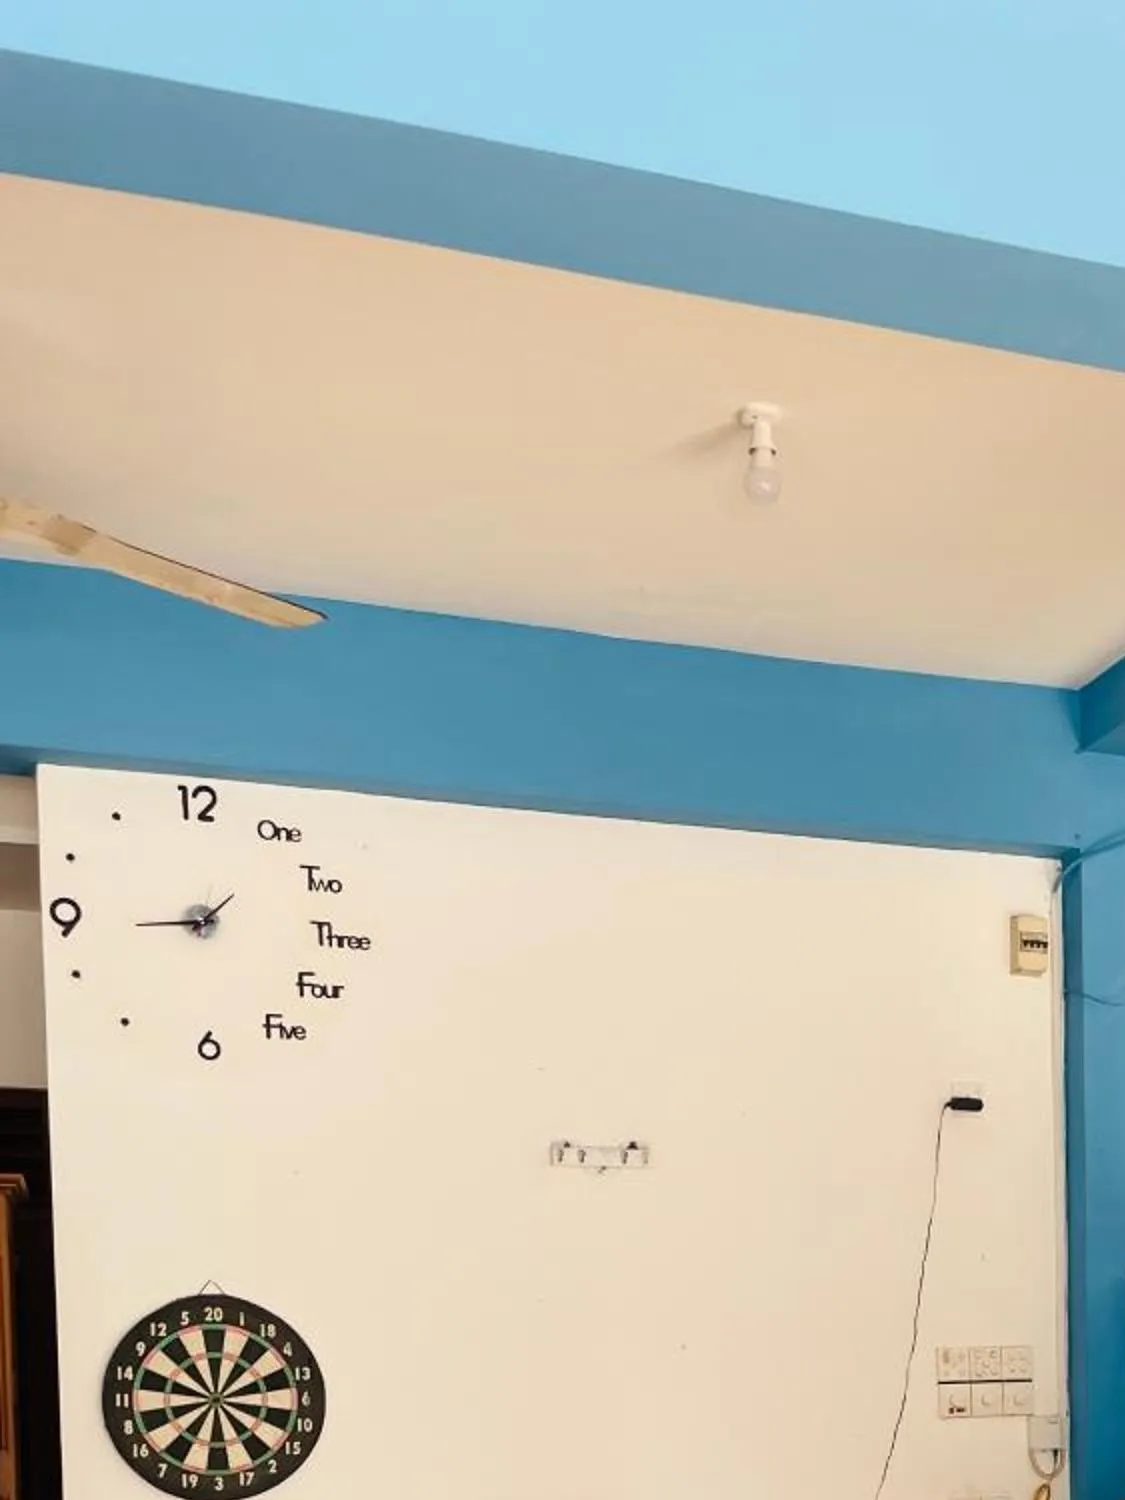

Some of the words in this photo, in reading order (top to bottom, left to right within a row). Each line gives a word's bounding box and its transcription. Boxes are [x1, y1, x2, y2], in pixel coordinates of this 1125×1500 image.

[177, 785, 218, 822] 12
[257, 819, 302, 843] One
[299, 864, 343, 893] Two
[50, 897, 82, 938] 9
[310, 920, 371, 951] Three
[296, 971, 345, 999] Four
[263, 1013, 307, 1041] Five
[197, 1030, 221, 1060] 6
[180, 1311, 190, 1325] 5
[204, 1307, 224, 1321] 20
[239, 1311, 246, 1326] 1
[150, 1323, 167, 1337] 12
[260, 1323, 276, 1338] 18
[136, 1341, 146, 1357] 9
[283, 1342, 293, 1357] 4
[116, 1366, 133, 1381] 14
[295, 1366, 311, 1381] 13
[115, 1393, 130, 1408] 11
[301, 1393, 311, 1406] 6
[123, 1419, 133, 1435] 8
[297, 1418, 314, 1432] 10
[132, 1443, 149, 1458] 16
[285, 1441, 302, 1455] 15
[156, 1463, 168, 1478] 7
[268, 1460, 278, 1474] 2
[181, 1473, 199, 1488] 19
[214, 1478, 225, 1491] 3
[239, 1472, 255, 1486] 17
